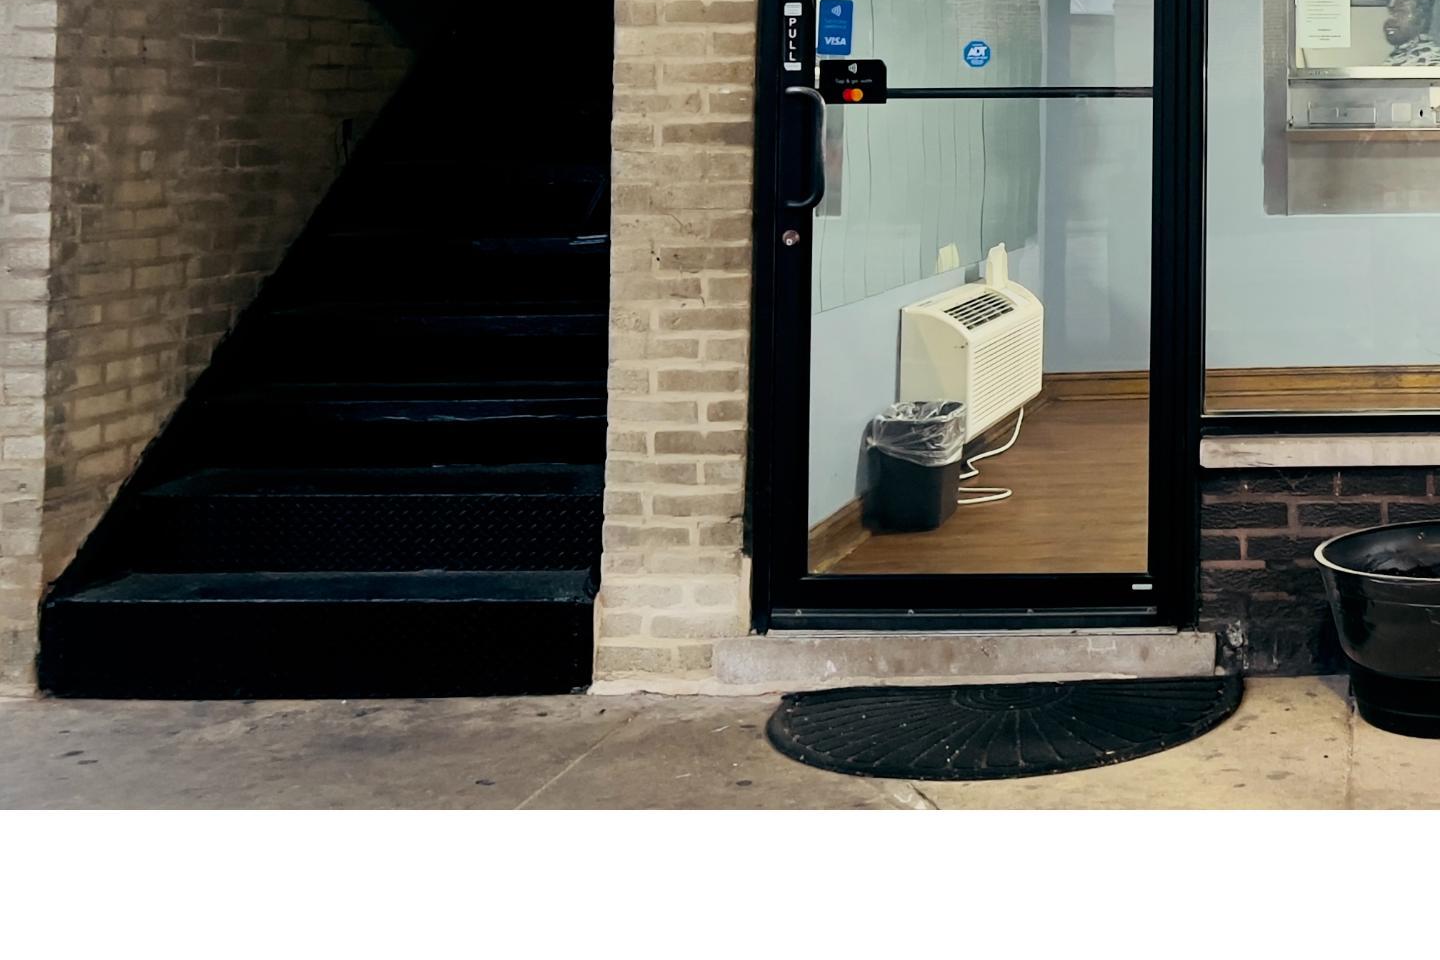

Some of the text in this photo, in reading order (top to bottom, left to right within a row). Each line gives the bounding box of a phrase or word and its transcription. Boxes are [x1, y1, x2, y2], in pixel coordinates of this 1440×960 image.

[788, 17, 798, 61] PULL
[824, 36, 847, 46] VISA
[967, 46, 988, 57] ADT
